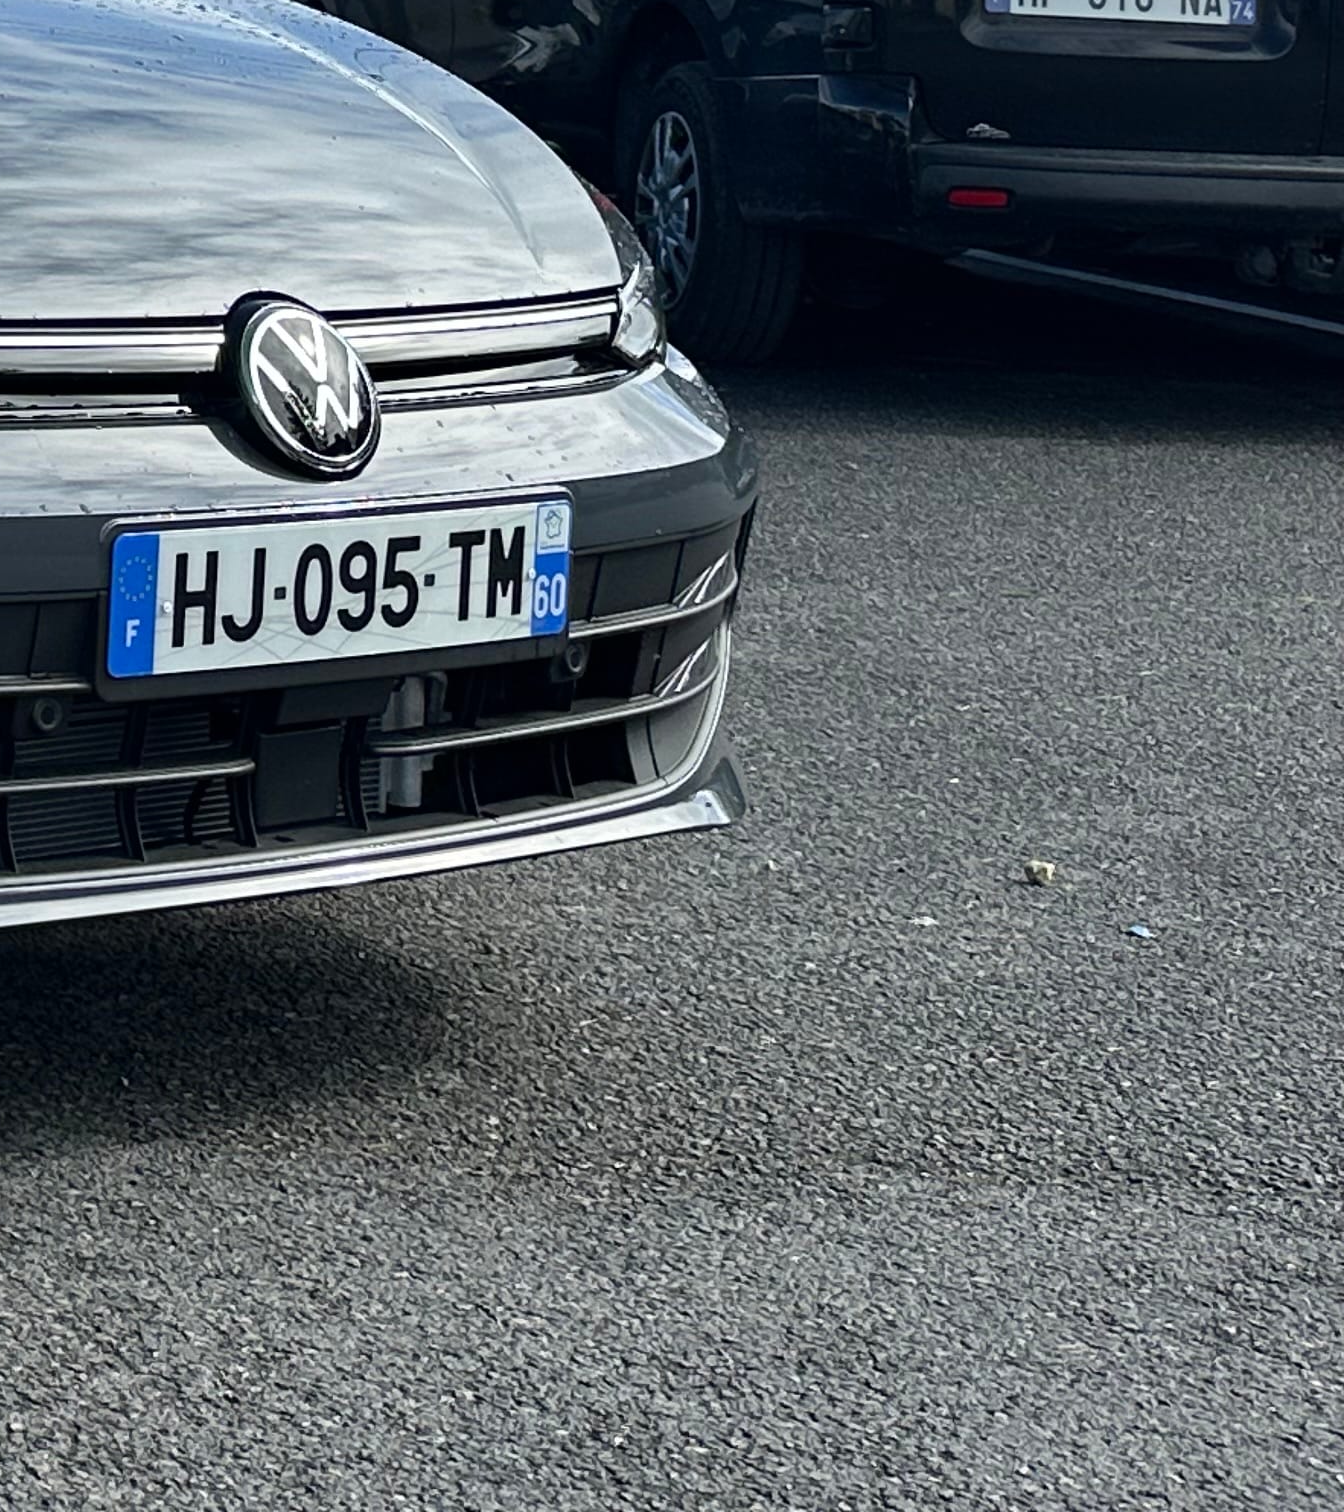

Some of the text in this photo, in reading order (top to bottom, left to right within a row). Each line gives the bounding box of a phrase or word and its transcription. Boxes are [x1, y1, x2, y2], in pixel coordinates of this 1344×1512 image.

[1232, 0, 1254, 20] 74
[171, 525, 526, 648] HJ-095-TM
[533, 572, 567, 619] 60
[126, 618, 140, 648] F
